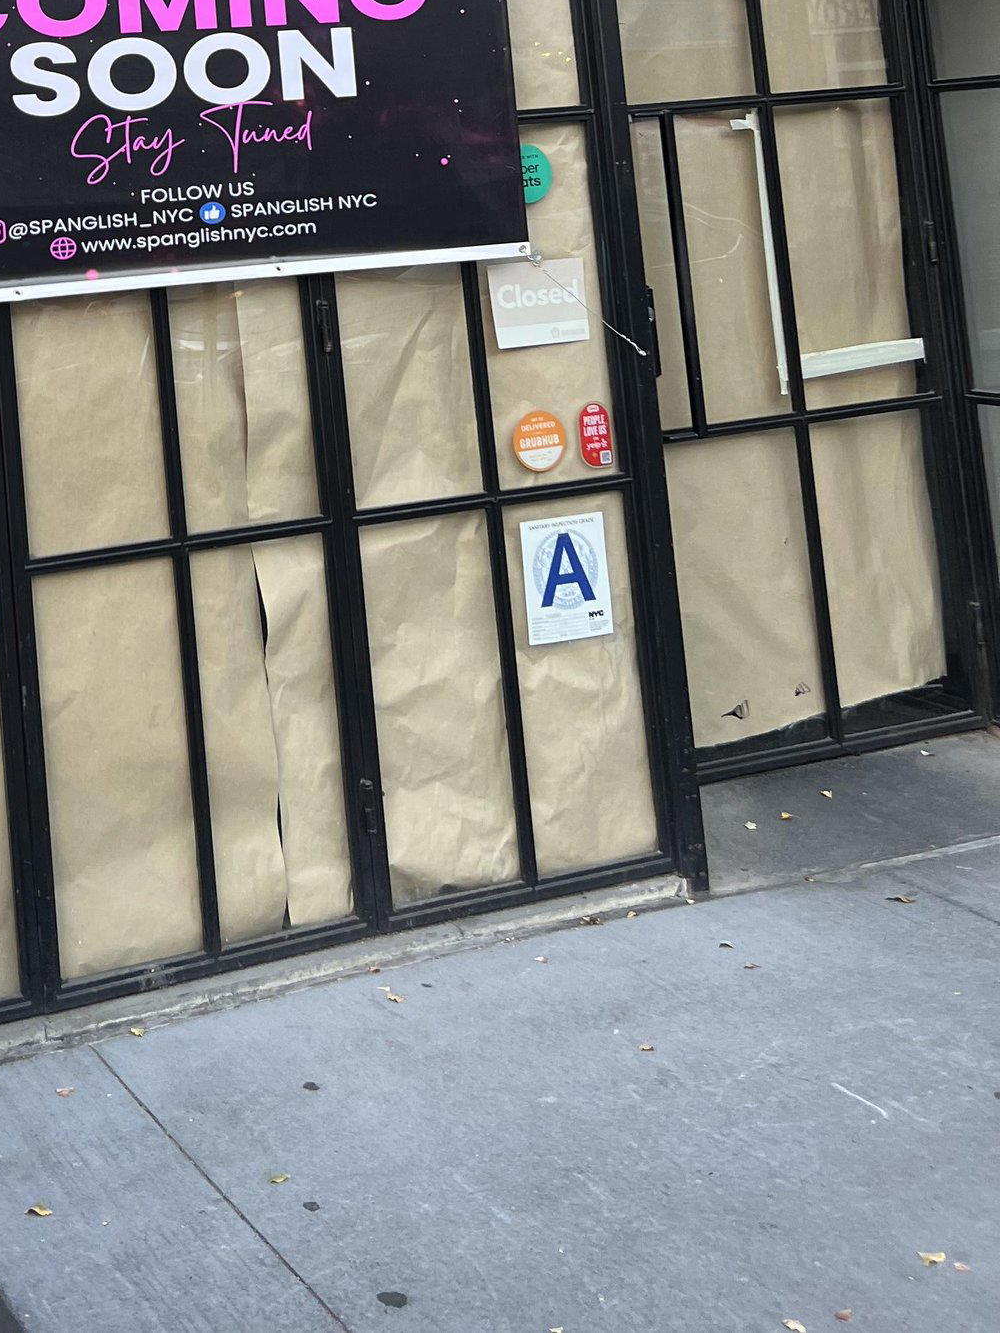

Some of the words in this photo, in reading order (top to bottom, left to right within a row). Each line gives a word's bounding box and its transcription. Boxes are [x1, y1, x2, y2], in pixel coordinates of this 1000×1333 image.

[11, 27, 358, 117] SOON
[70, 114, 186, 185] Stay
[199, 101, 313, 174] Tuned
[140, 184, 223, 205] FOLLOW
[228, 182, 255, 198] US
[8, 208, 194, 240] @SPANGLISH_NYC
[231, 197, 333, 219] SPANGLISH
[338, 193, 378, 211] NYC
[81, 220, 317, 255] www.spanglishnyc.com
[497, 278, 579, 309] Closed
[583, 414, 605, 426] PEOPLE
[583, 425, 598, 437] LOVE
[598, 424, 607, 435] US
[519, 433, 560, 449] GRUBHUB
[541, 533, 596, 607] A
[588, 610, 604, 619] NYC
